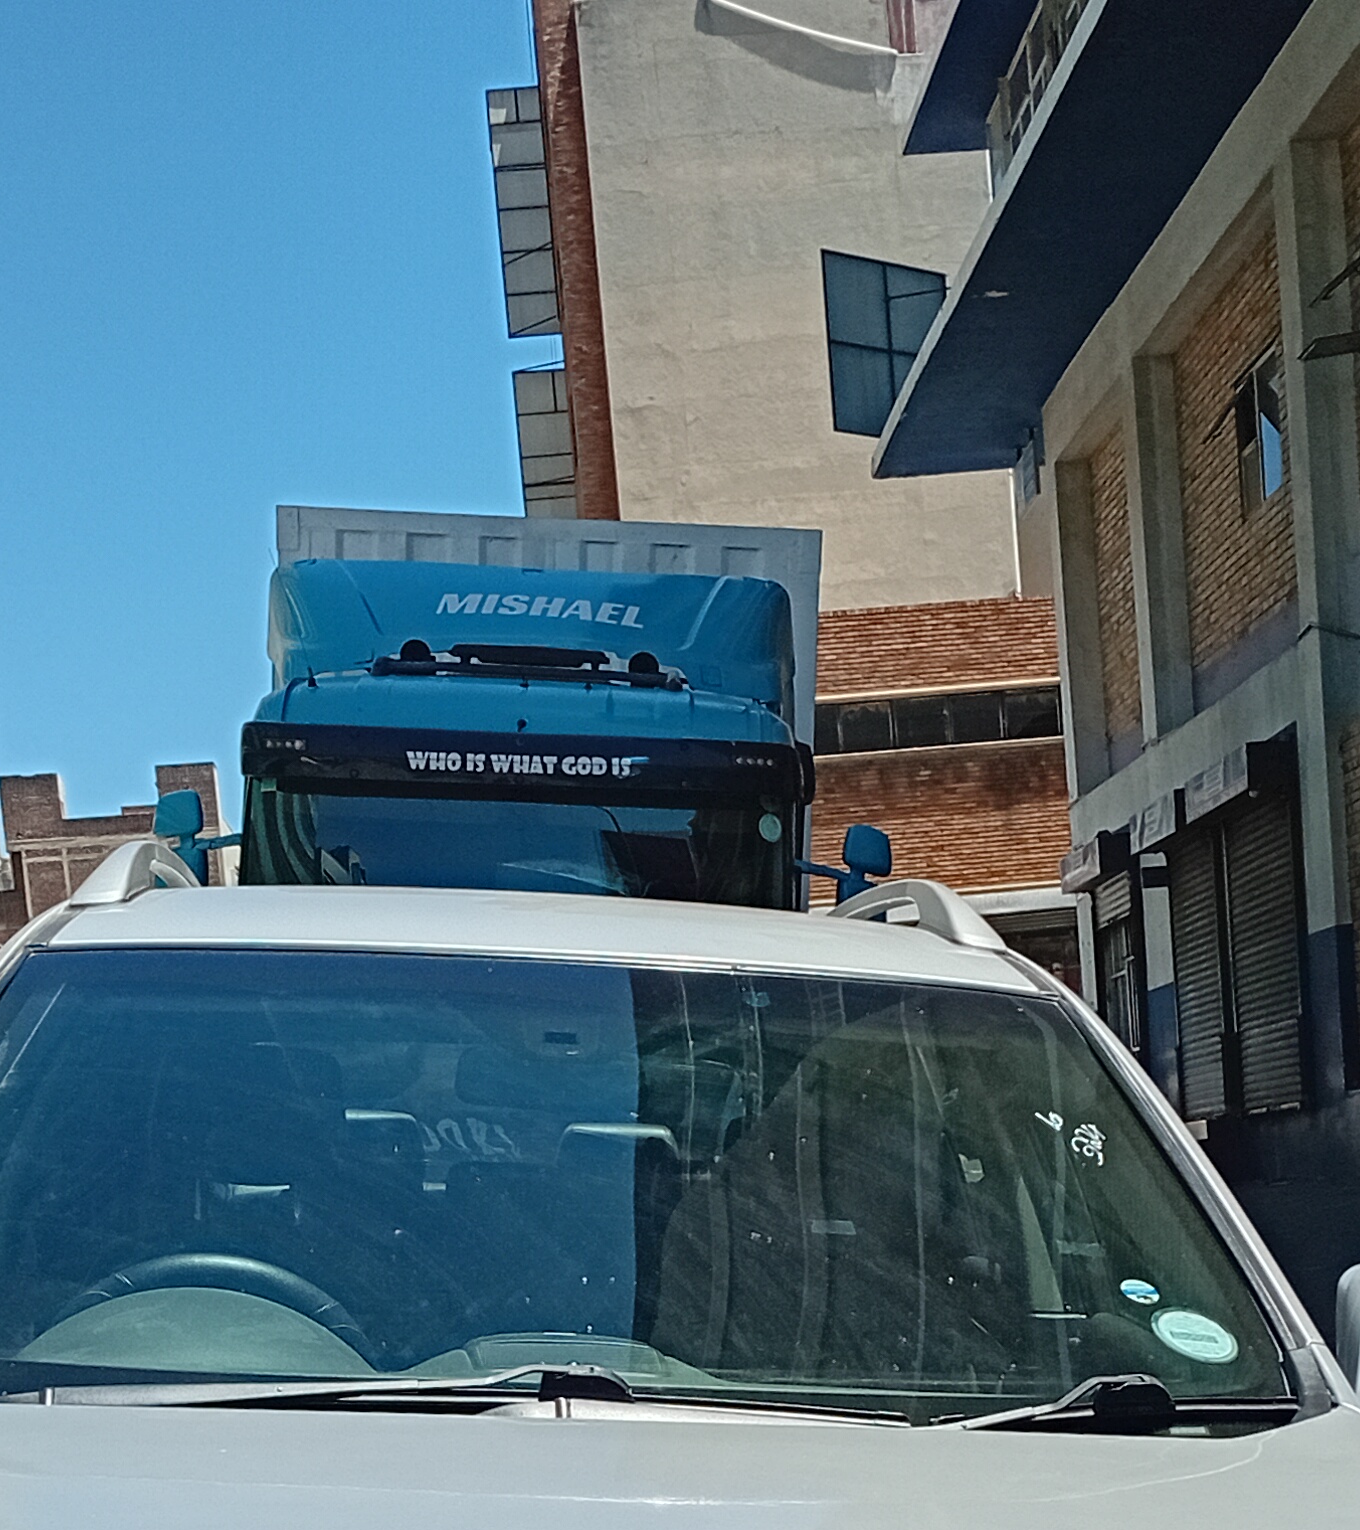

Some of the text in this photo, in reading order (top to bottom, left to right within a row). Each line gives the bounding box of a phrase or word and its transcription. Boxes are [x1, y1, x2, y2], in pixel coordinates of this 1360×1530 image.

[436, 593, 643, 629] MISHAEL
[406, 750, 631, 777] WHO IS WHAT GOD IS
